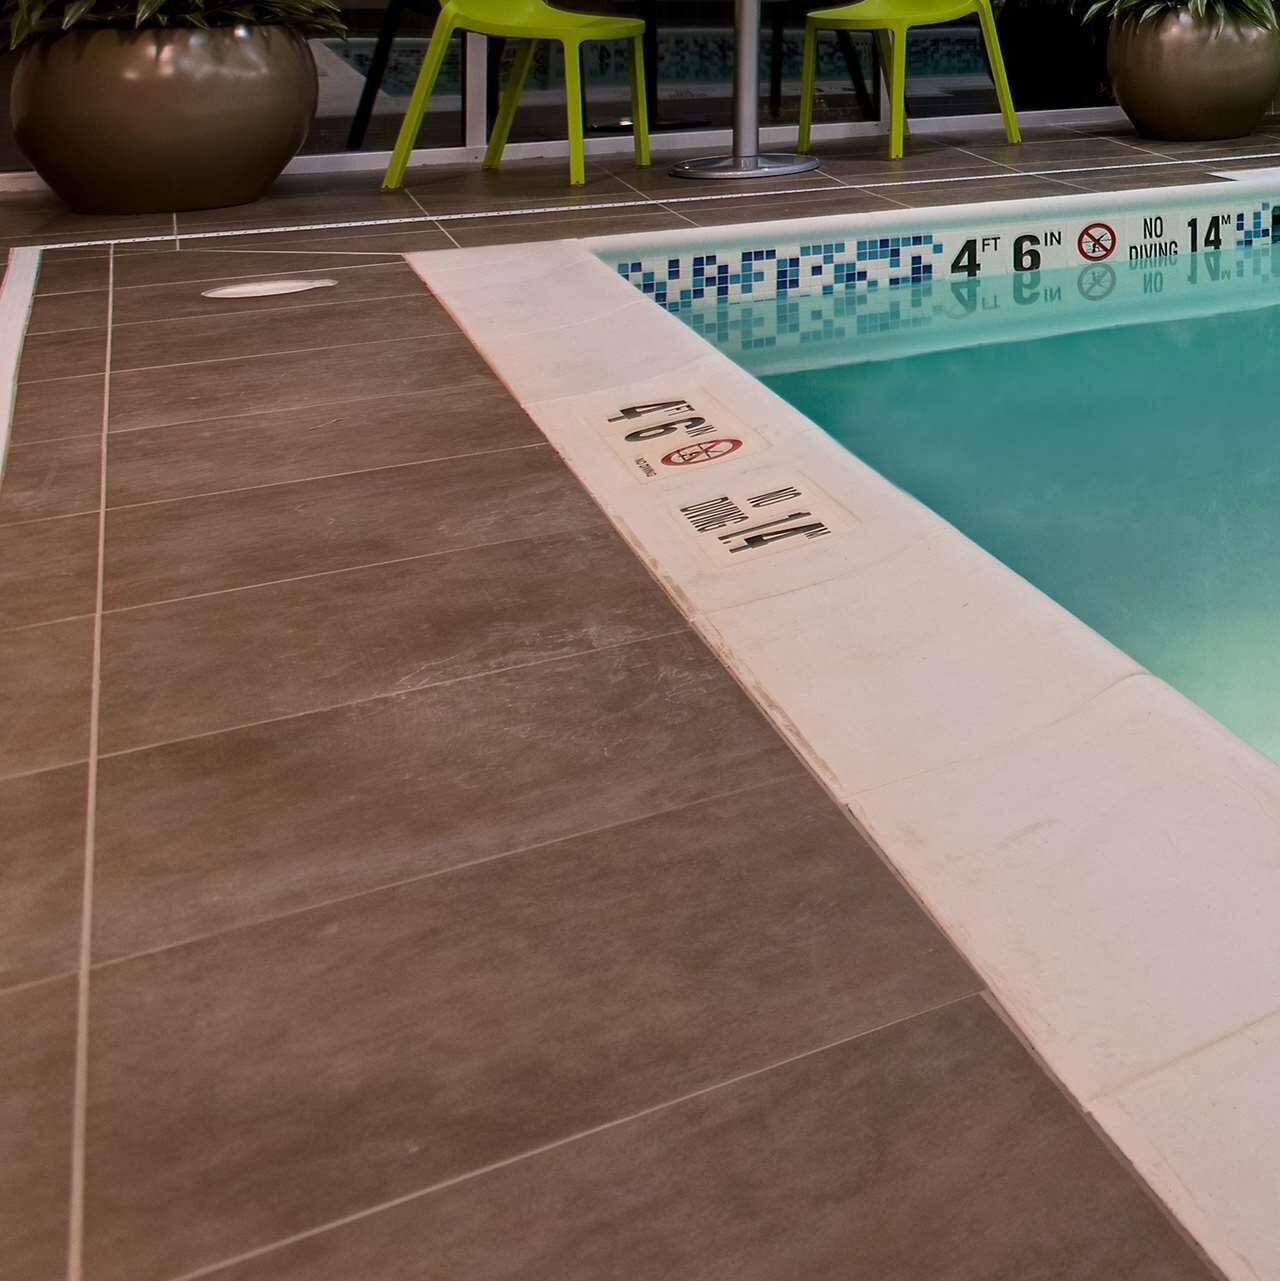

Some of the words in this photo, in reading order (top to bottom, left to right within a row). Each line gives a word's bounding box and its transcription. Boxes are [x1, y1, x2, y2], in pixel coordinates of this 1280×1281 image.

[1143, 216, 1164, 240] NO
[1129, 241, 1178, 261] DIVING
[747, 486, 802, 508] NO
[680, 496, 750, 532] DIVING
